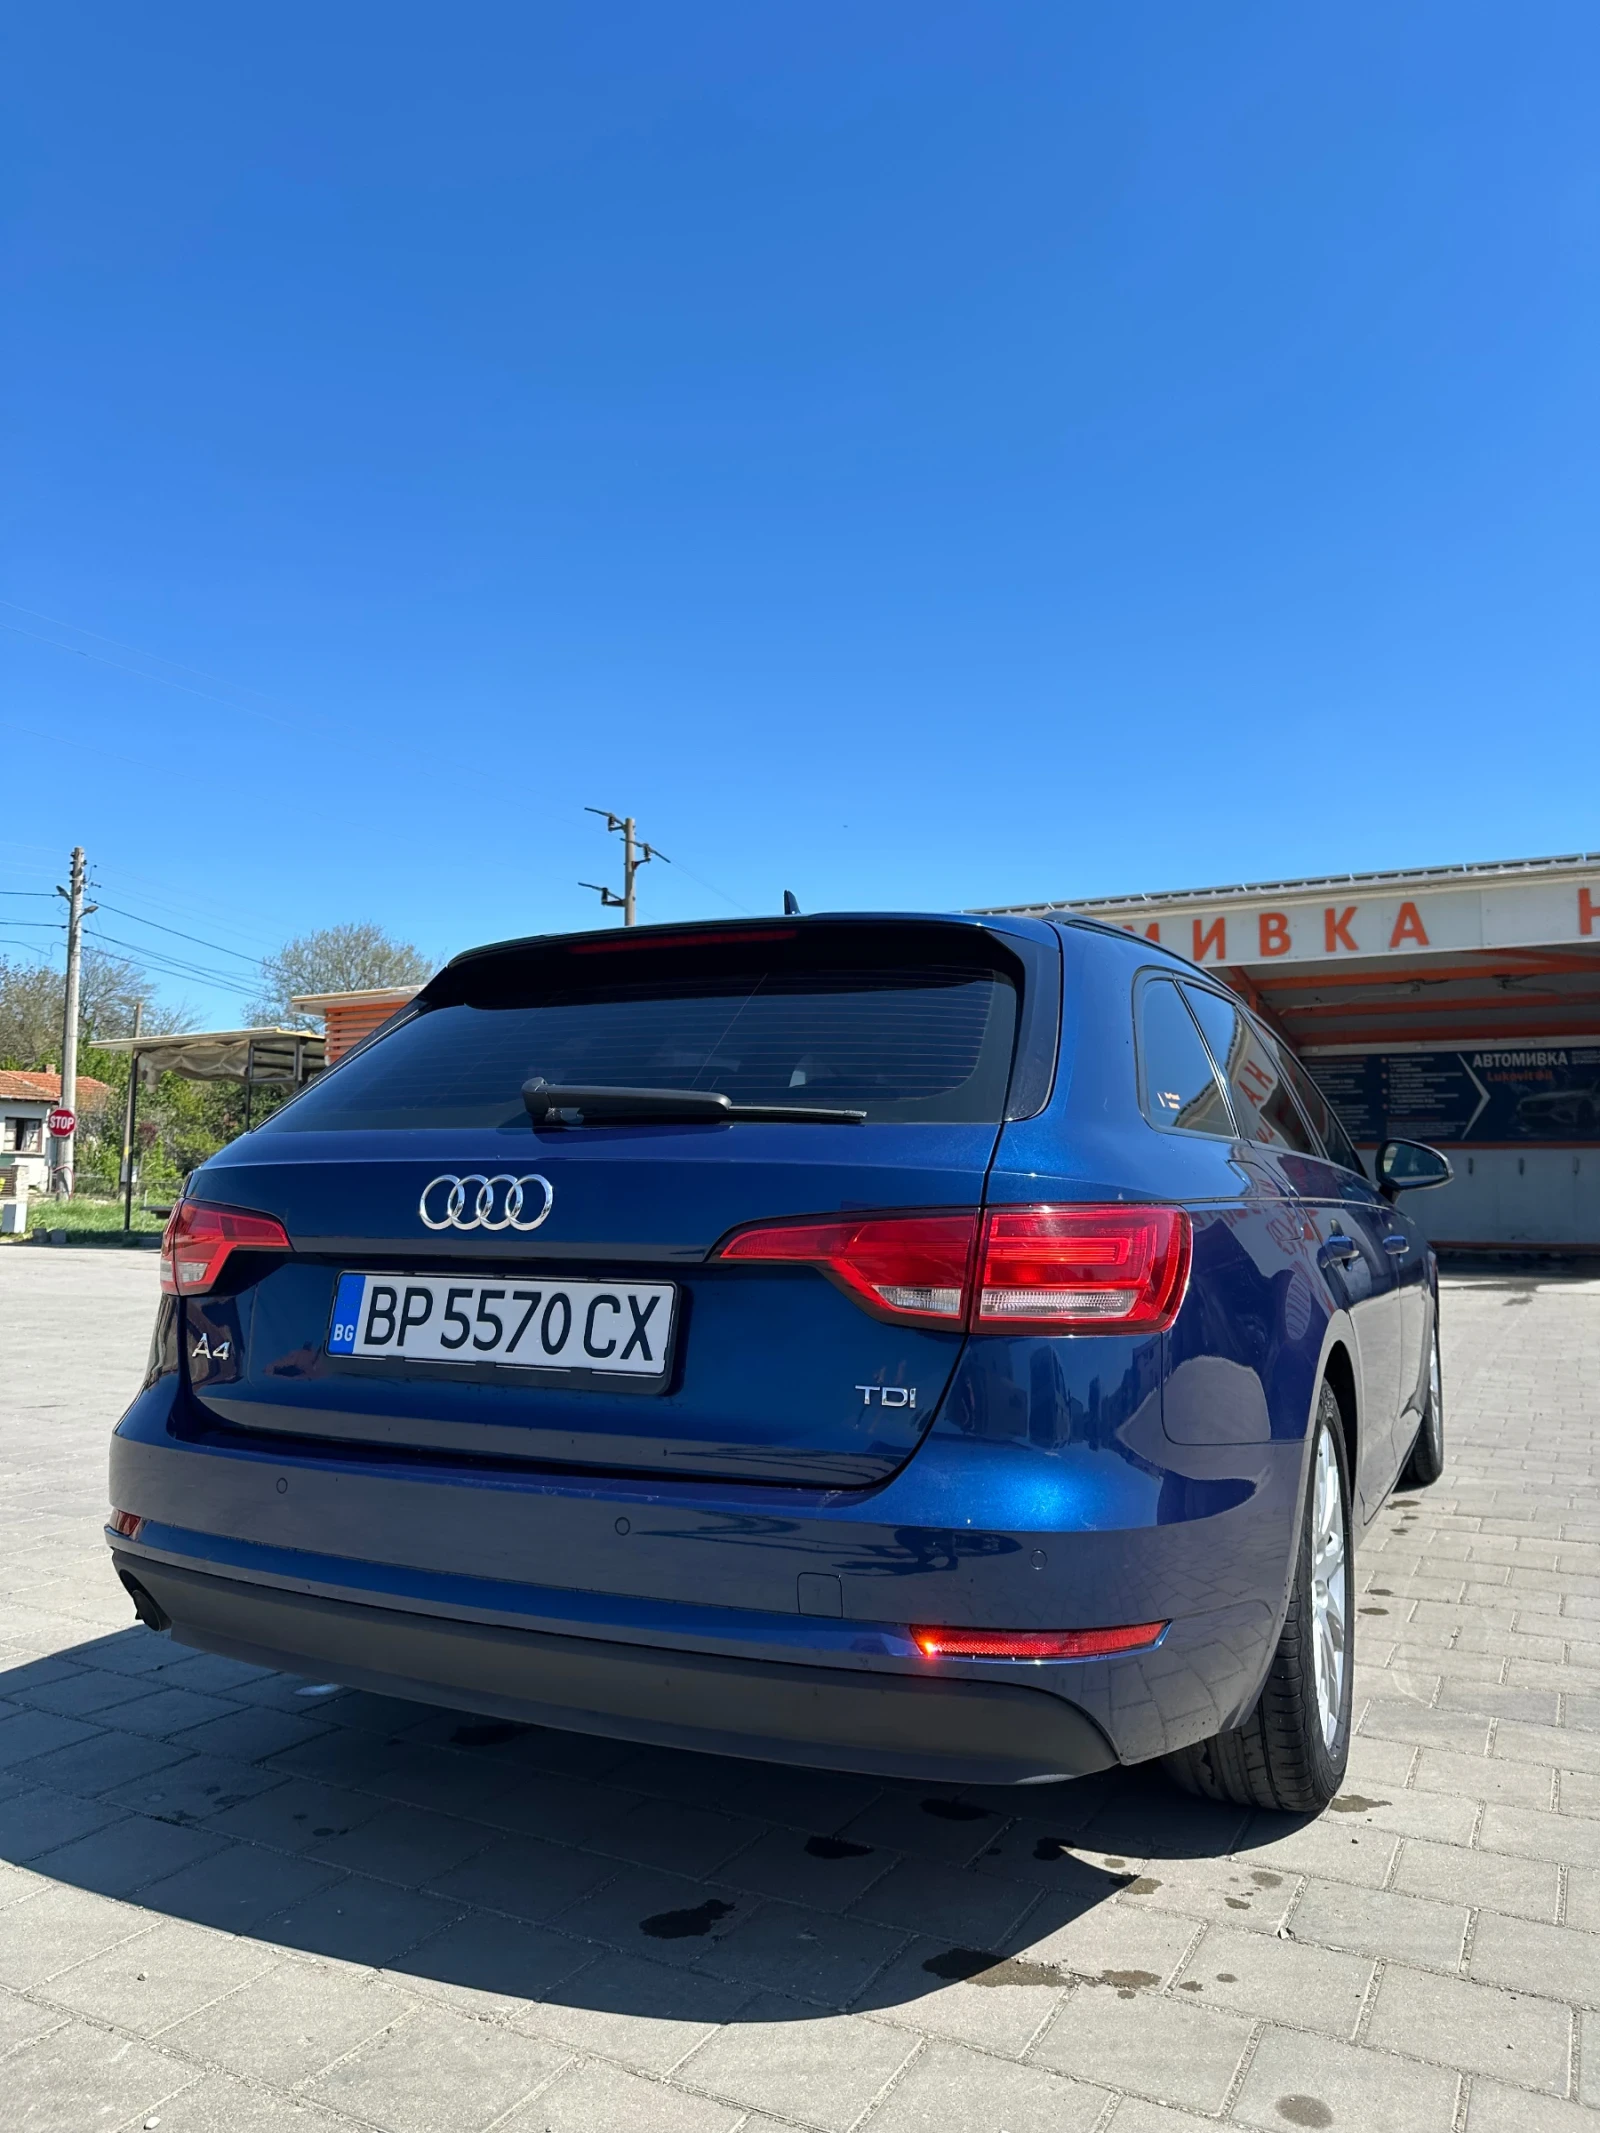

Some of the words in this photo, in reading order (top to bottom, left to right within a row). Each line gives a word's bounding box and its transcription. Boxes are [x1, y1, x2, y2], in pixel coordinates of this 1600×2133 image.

[1472, 1051, 1569, 1068] АВТОМИВКА
[50, 1115, 75, 1130] STOP
[333, 1323, 355, 1342] BG
[191, 1332, 230, 1360] A4
[855, 1385, 916, 1408] TDI
